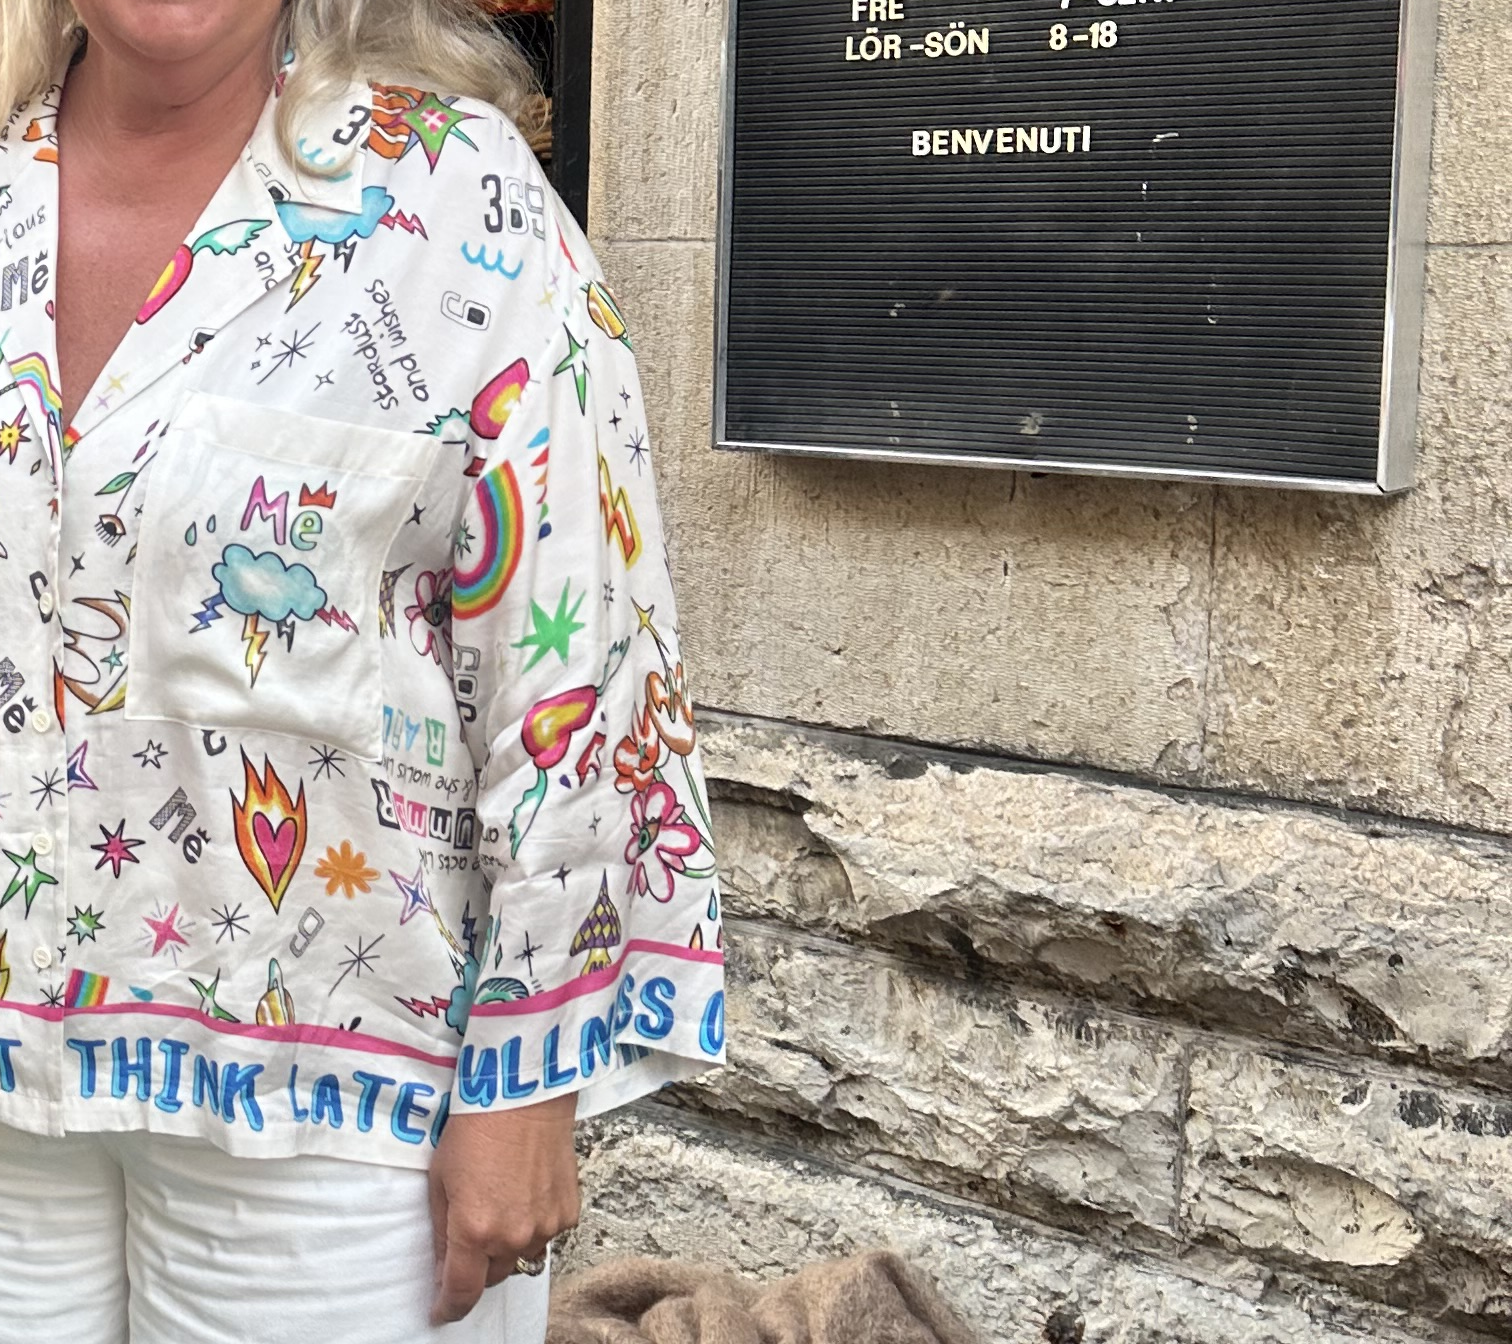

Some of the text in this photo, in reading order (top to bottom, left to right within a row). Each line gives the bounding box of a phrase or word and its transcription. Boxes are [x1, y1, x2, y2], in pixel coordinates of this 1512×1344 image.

[912, 126, 1090, 155] BENVENUTI
[0, 255, 49, 312] Me
[364, 277, 408, 349] wishes
[241, 475, 324, 551] Me
[67, 1036, 265, 1133] THINK
